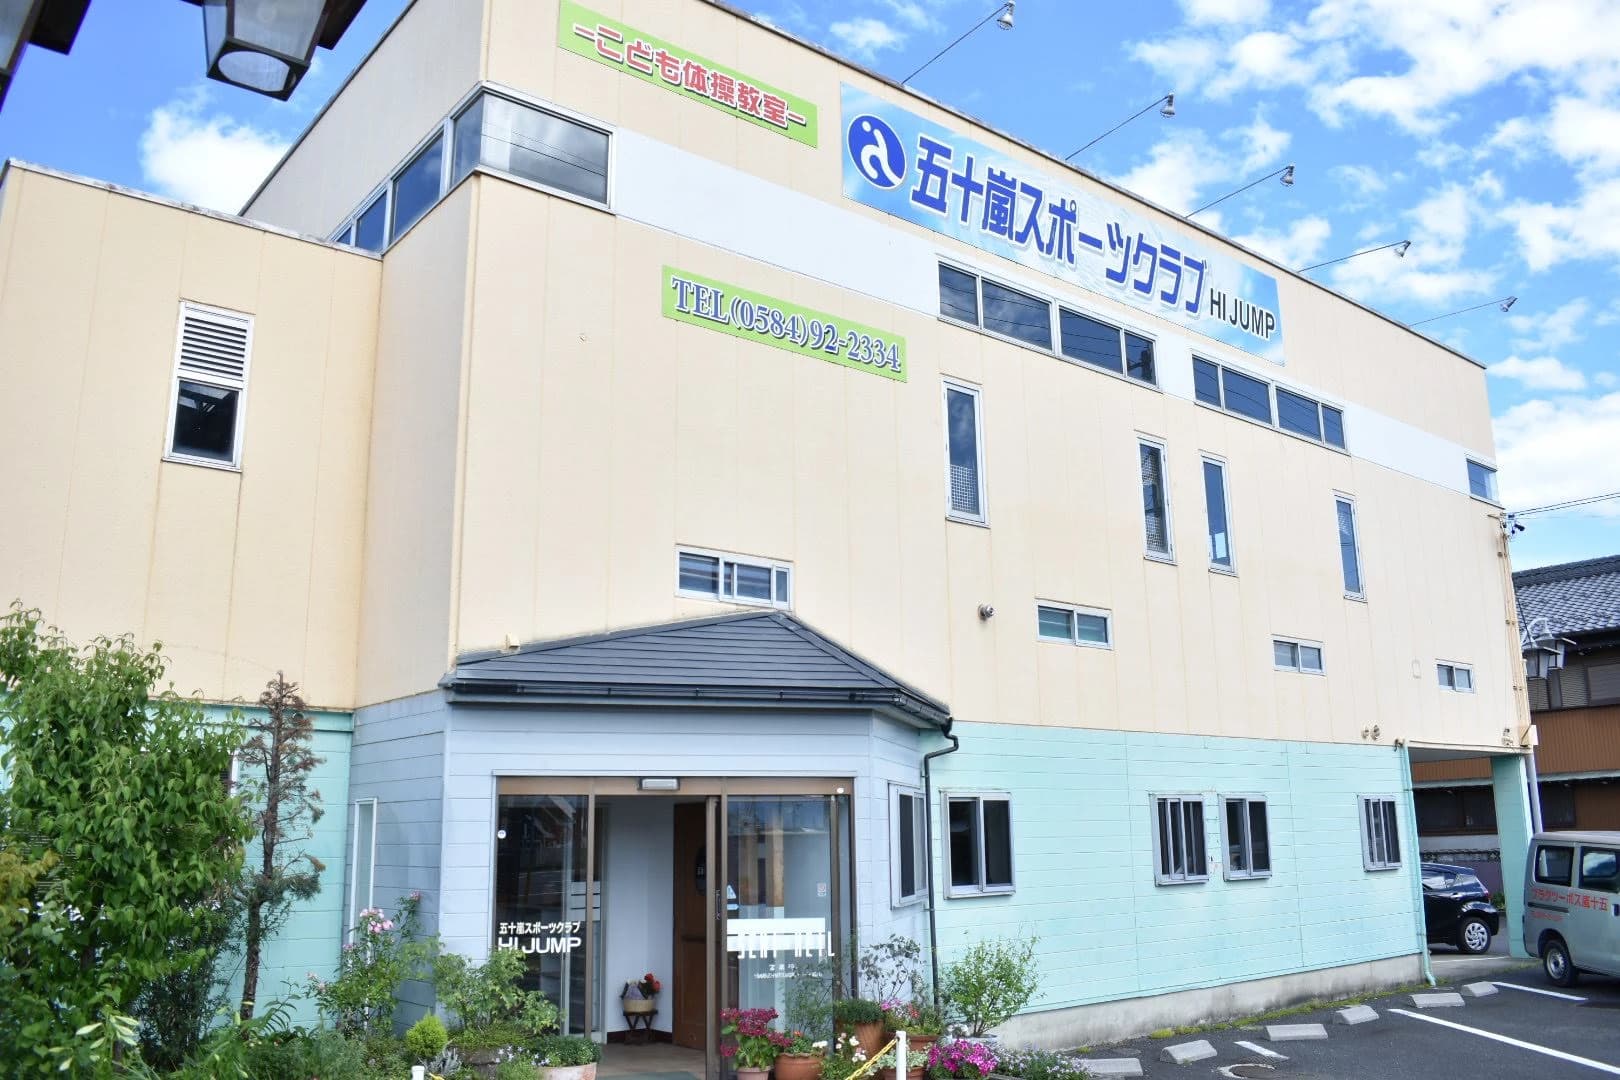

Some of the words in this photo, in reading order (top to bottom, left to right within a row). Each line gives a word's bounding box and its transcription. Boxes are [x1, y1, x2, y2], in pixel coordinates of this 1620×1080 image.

[910, 133, 1208, 315] 五十嵐スポーツクラブ
[1209, 287, 1227, 322] HI
[1228, 297, 1276, 340] JUMP
[497, 936, 519, 952] HI
[521, 936, 582, 954] JUMP
[498, 921, 582, 935] 五十嵐スポーツクラブ
